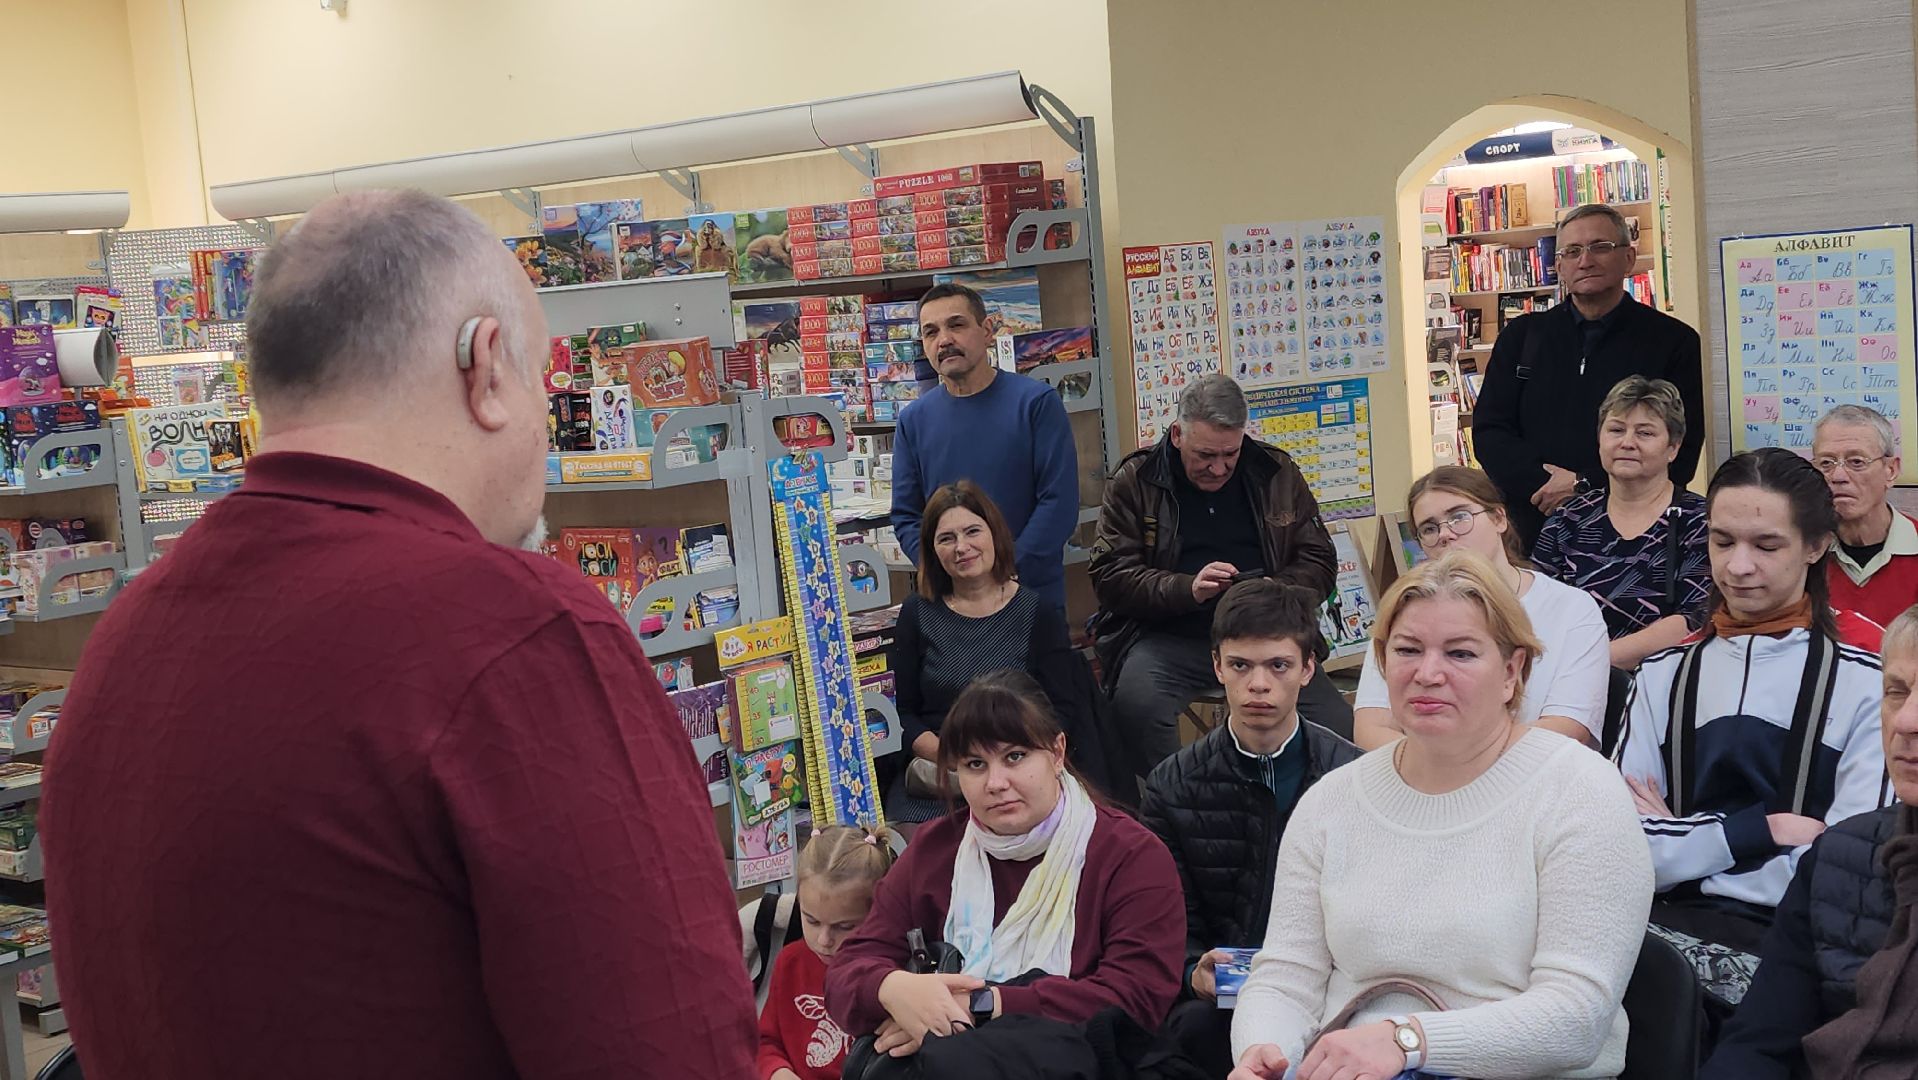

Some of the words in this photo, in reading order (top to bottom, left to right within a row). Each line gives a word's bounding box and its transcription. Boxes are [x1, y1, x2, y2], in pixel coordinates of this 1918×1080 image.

[1486, 143, 1520, 156] СПОРТ
[899, 176, 934, 188] PUZZLE
[1247, 228, 1270, 236] АЗБУКА
[1326, 223, 1354, 231] АЗБУКА
[1774, 236, 1855, 252] АЛФАВИТ
[1125, 250, 1159, 263] РУССКИЙ
[1164, 250, 1175, 263] Аа
[1181, 248, 1192, 261] Бб
[1777, 258, 1790, 266] Бб
[1126, 262, 1160, 275] АЛФАВИТ
[1198, 275, 1213, 288] Жж
[1858, 281, 1878, 289] Жж
[1134, 310, 1144, 324] Зз
[1741, 316, 1754, 324] Зз
[1779, 313, 1792, 322] Ии
[1860, 310, 1873, 318] Кк
[1169, 334, 1181, 348] Оо
[1186, 333, 1197, 346] Пп
[1204, 330, 1215, 344] Рр
[1781, 342, 1798, 350] Мм
[1821, 340, 1834, 348] Нн
[1861, 338, 1876, 346] Оо
[1881, 346, 1896, 360] Оо
[1137, 368, 1148, 381] Сс
[1187, 361, 1202, 375] Фф
[1206, 358, 1217, 372] Хх
[1782, 369, 1796, 378] Рр
[1822, 367, 1835, 375] Сс
[1745, 398, 1757, 406] Уу
[1783, 397, 1801, 406] Фф
[1863, 395, 1879, 404] Цц
[1746, 424, 1759, 432] Чч
[1784, 423, 1803, 432] Шш
[580, 540, 613, 559] ТОСИ
[580, 558, 616, 576] БОСИ
[747, 642, 754, 652] Я
[756, 632, 791, 651] РАСТУ!
[753, 712, 760, 720] 35
[744, 855, 788, 874] РОСТОМЕР
